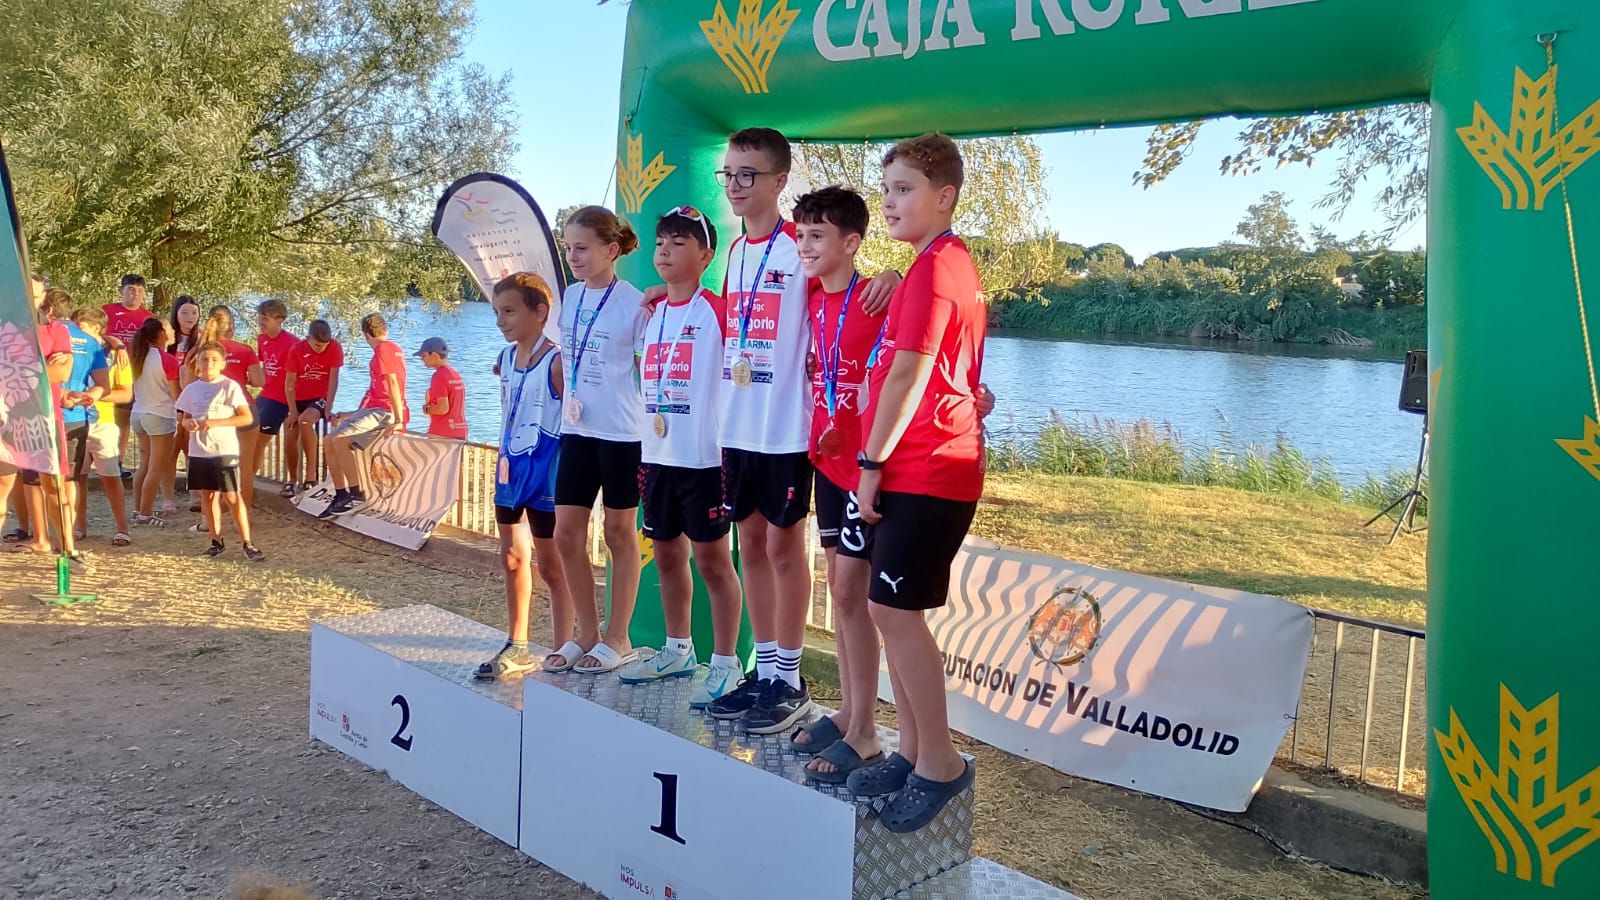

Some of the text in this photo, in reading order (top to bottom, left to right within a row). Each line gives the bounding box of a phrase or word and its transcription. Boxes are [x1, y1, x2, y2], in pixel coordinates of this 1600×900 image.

[813, 0, 986, 62] CAJA
[390, 694, 414, 752] 2
[1022, 678, 1057, 708] DE
[1066, 681, 1241, 757] VALLADOLID
[650, 771, 687, 846] 1
